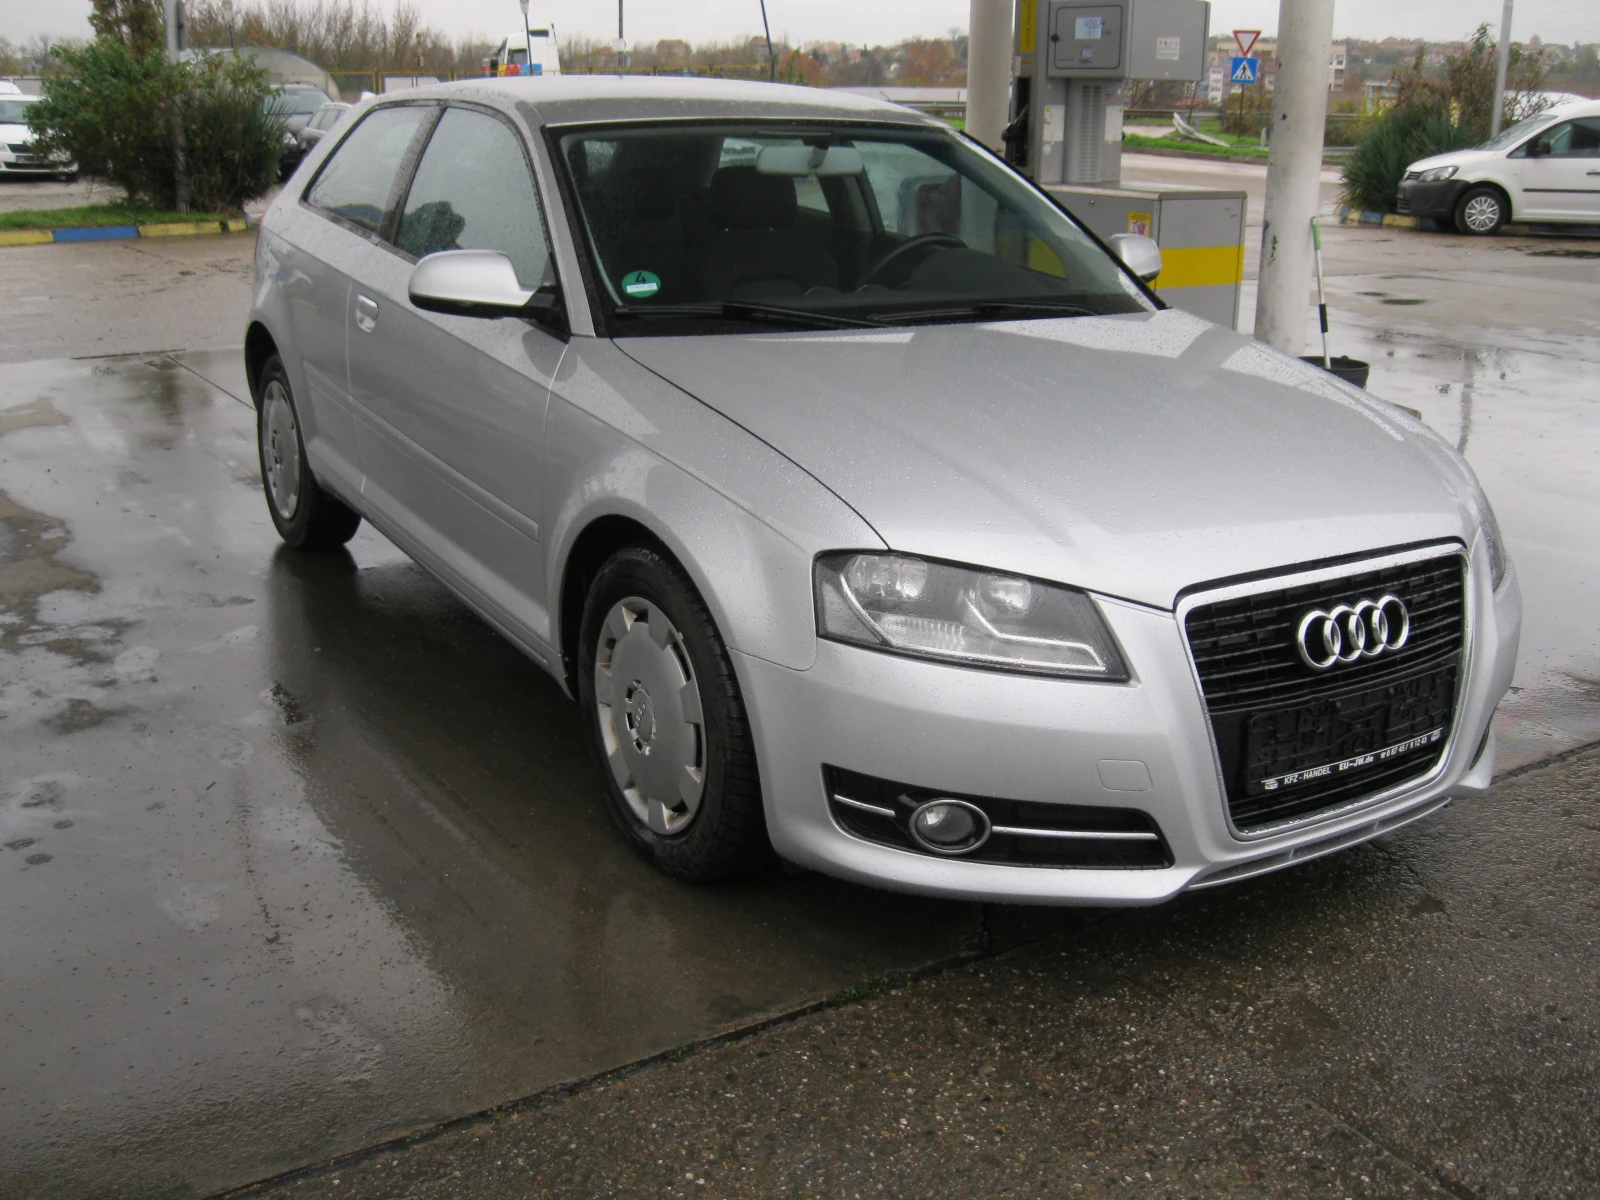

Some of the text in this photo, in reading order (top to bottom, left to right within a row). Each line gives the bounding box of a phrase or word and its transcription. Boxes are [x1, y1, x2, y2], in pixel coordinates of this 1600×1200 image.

[635, 271, 647, 284] 4
[1284, 774, 1298, 785] KFZ
[1303, 766, 1331, 780] HANDEL
[1338, 755, 1374, 771] EU-JW.de
